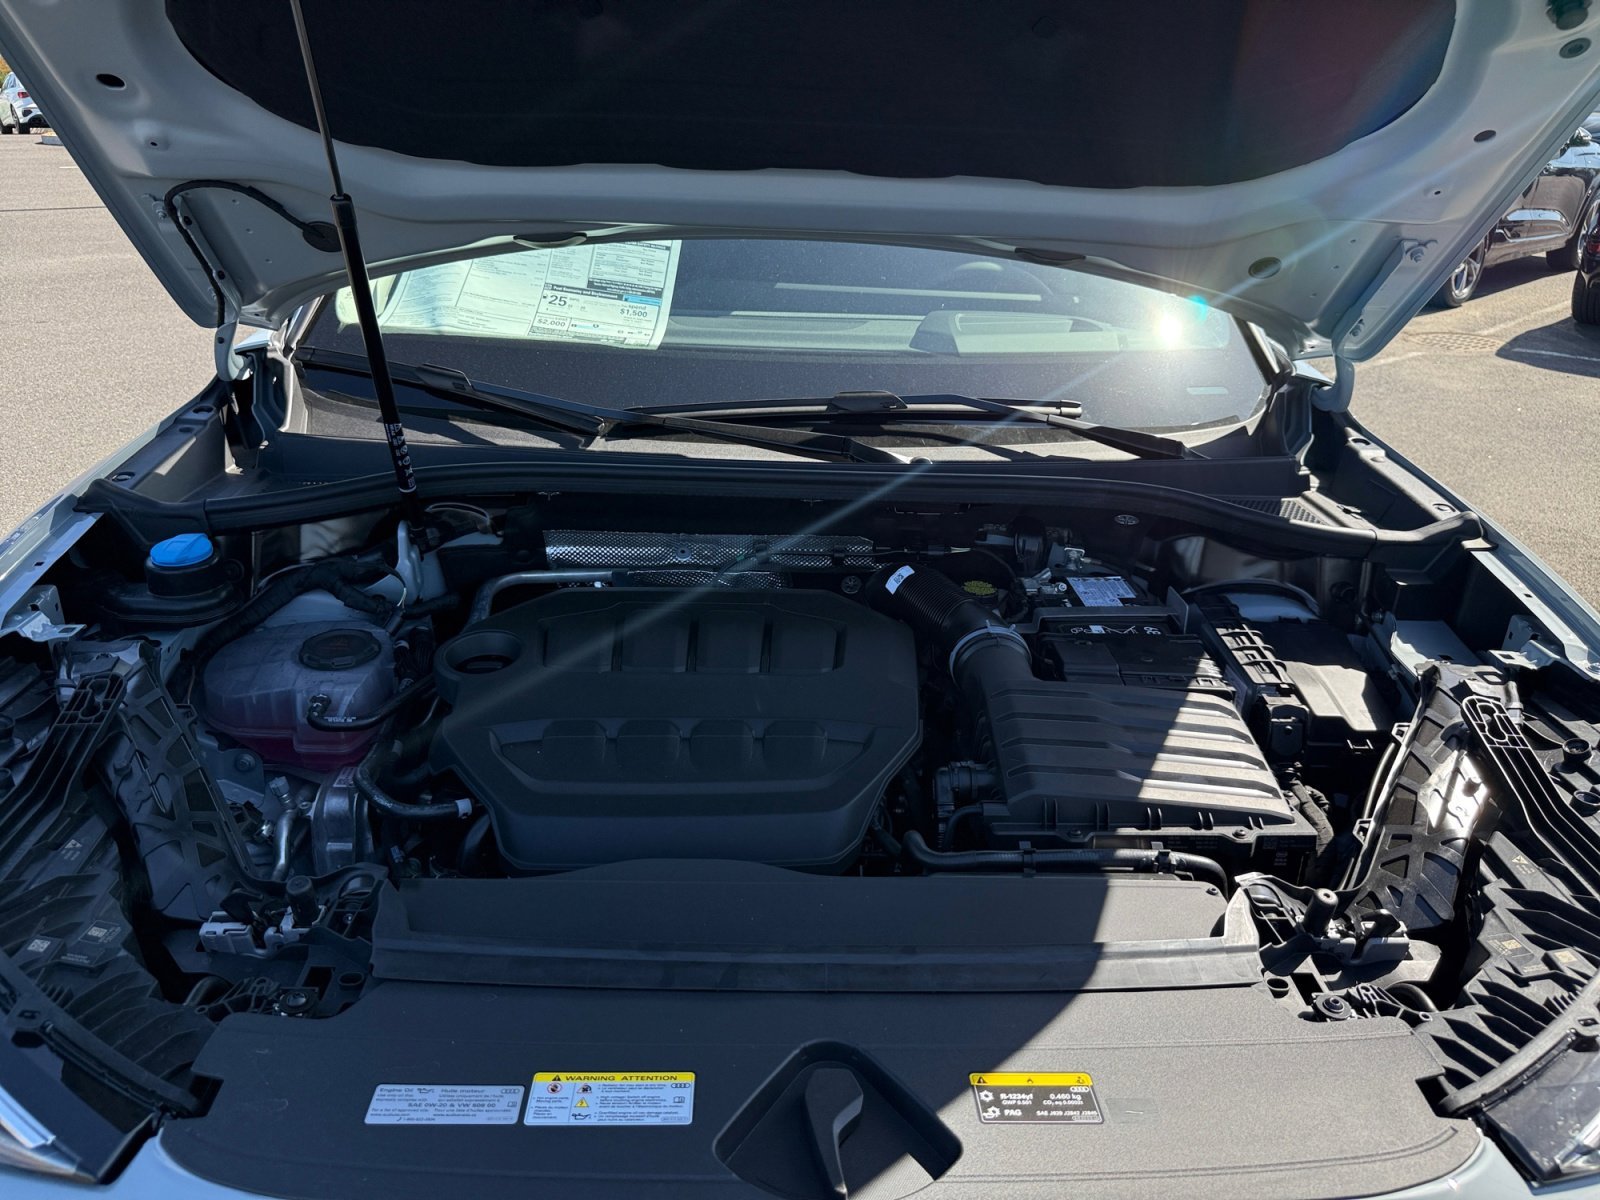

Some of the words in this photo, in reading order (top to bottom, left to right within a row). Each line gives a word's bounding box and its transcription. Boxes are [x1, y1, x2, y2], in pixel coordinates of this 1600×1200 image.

[548, 294, 568, 306] 25
[628, 303, 647, 311] spend
[620, 308, 648, 318] $1,500
[537, 318, 566, 327] $2,000
[1071, 1093, 1082, 1101] kg
